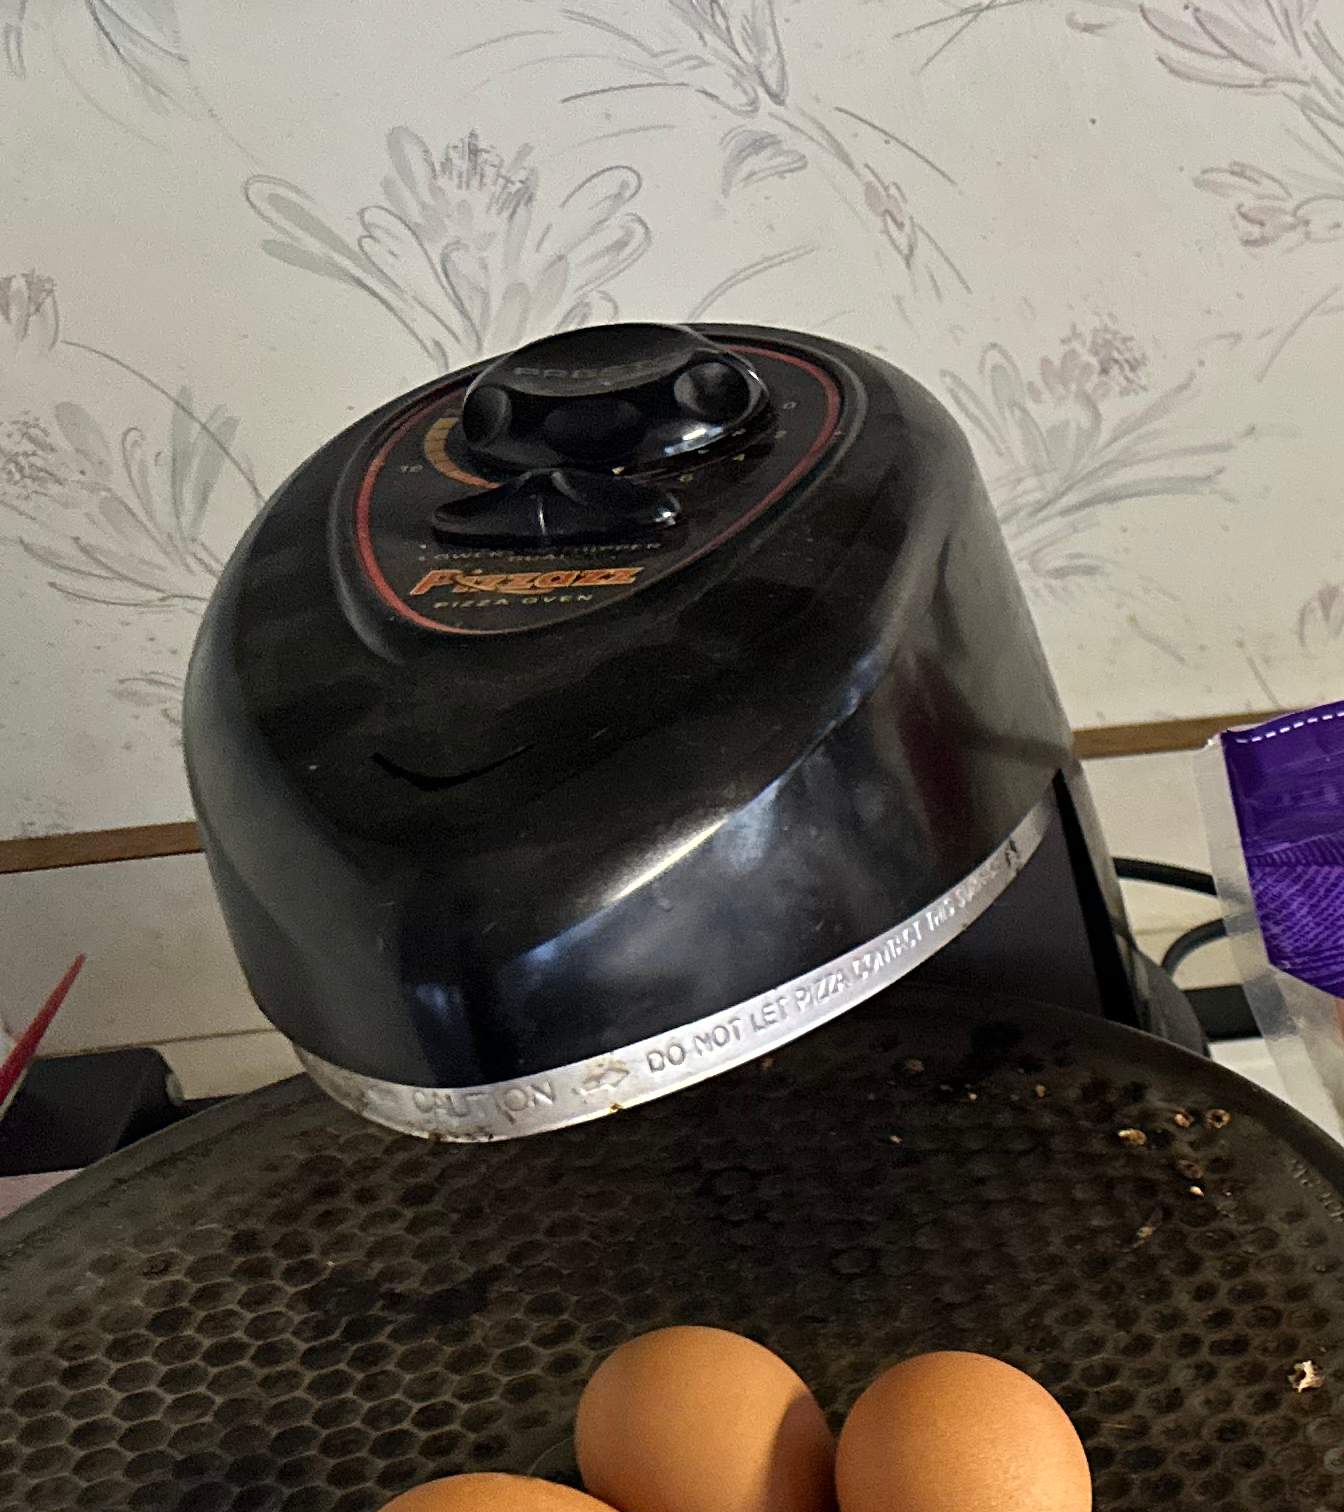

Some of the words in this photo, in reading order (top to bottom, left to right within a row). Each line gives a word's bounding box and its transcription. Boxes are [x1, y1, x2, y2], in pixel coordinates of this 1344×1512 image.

[409, 567, 644, 596] Pizzazz
[646, 1042, 686, 1074] DO
[693, 1016, 744, 1057] NOT
[750, 995, 790, 1033] LET
